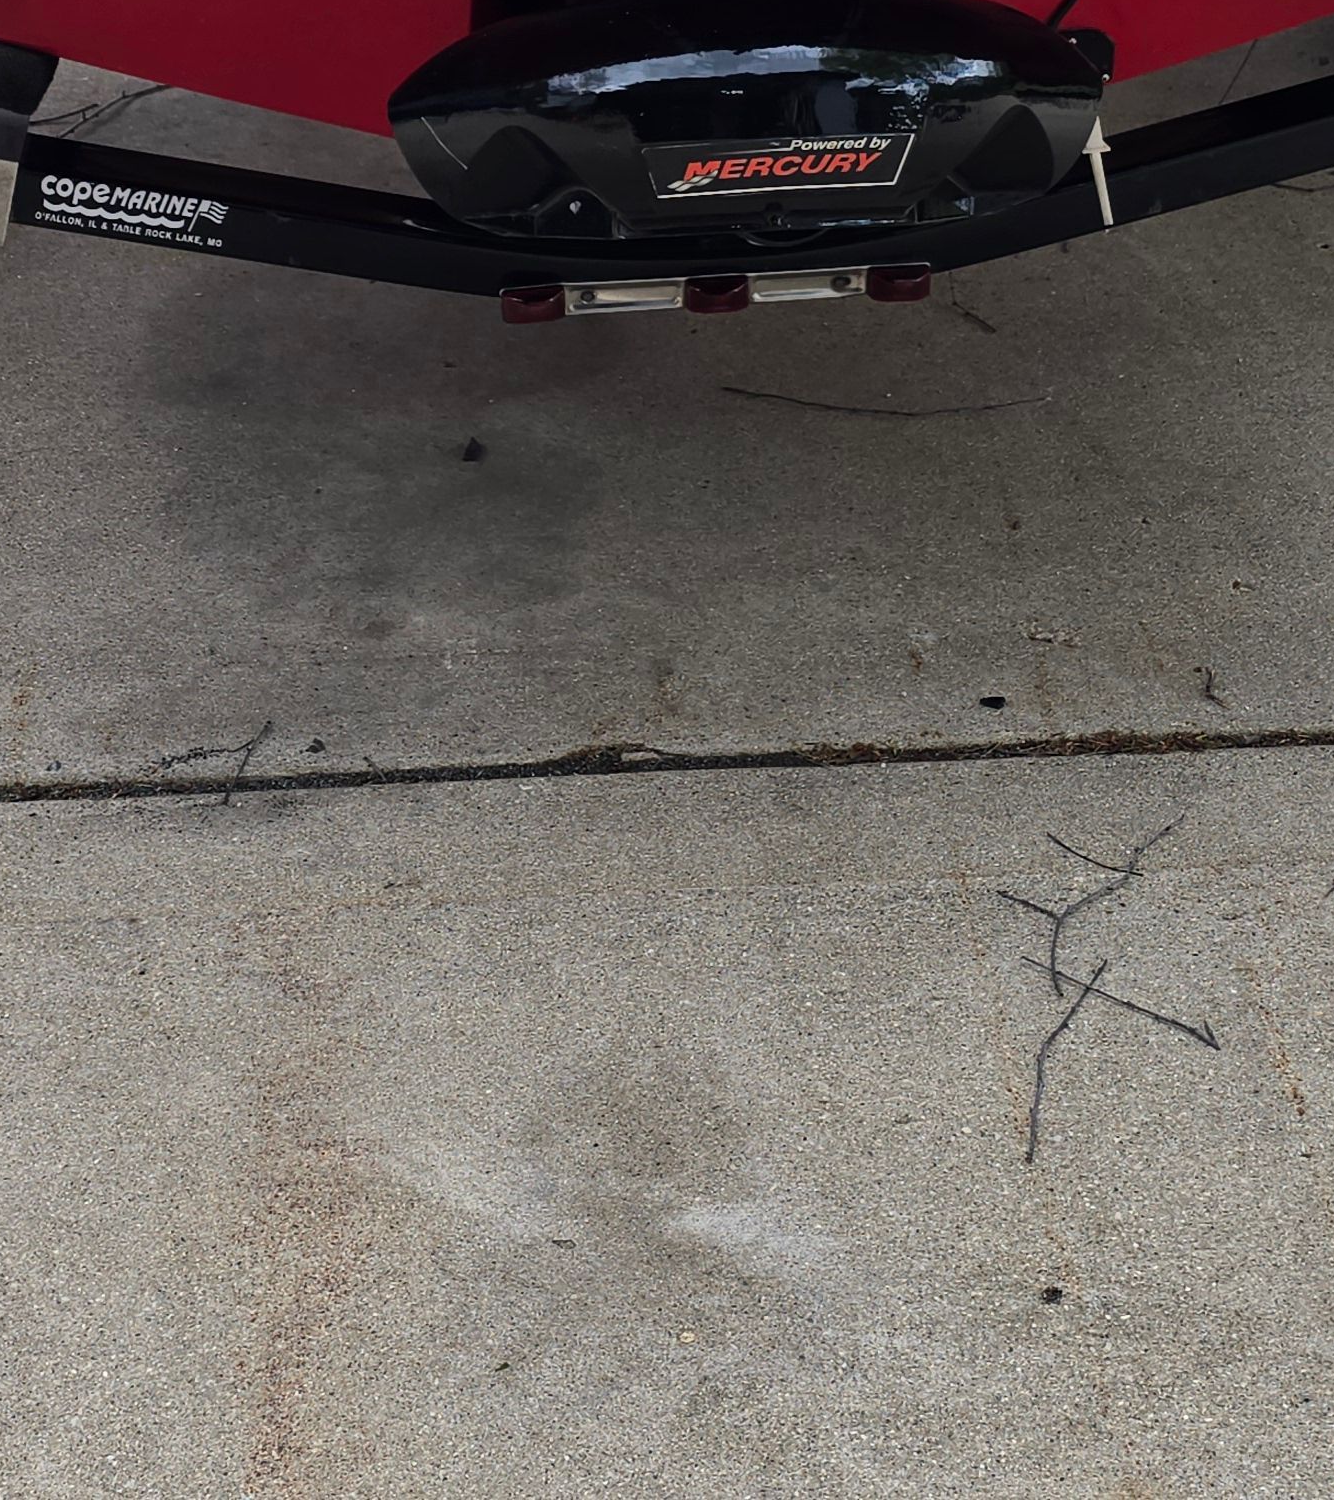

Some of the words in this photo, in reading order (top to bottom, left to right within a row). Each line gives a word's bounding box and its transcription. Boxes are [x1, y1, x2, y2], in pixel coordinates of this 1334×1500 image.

[789, 137, 867, 151] Powered
[870, 137, 891, 151] by
[683, 152, 883, 181] MERCURY
[35, 211, 84, 228] O'FALLON,
[88, 220, 97, 229] IL
[100, 222, 108, 230] &
[112, 223, 141, 235] TABLE
[145, 228, 172, 240] ROCK
[175, 234, 203, 246] LAKE,
[207, 238, 222, 247] MO
